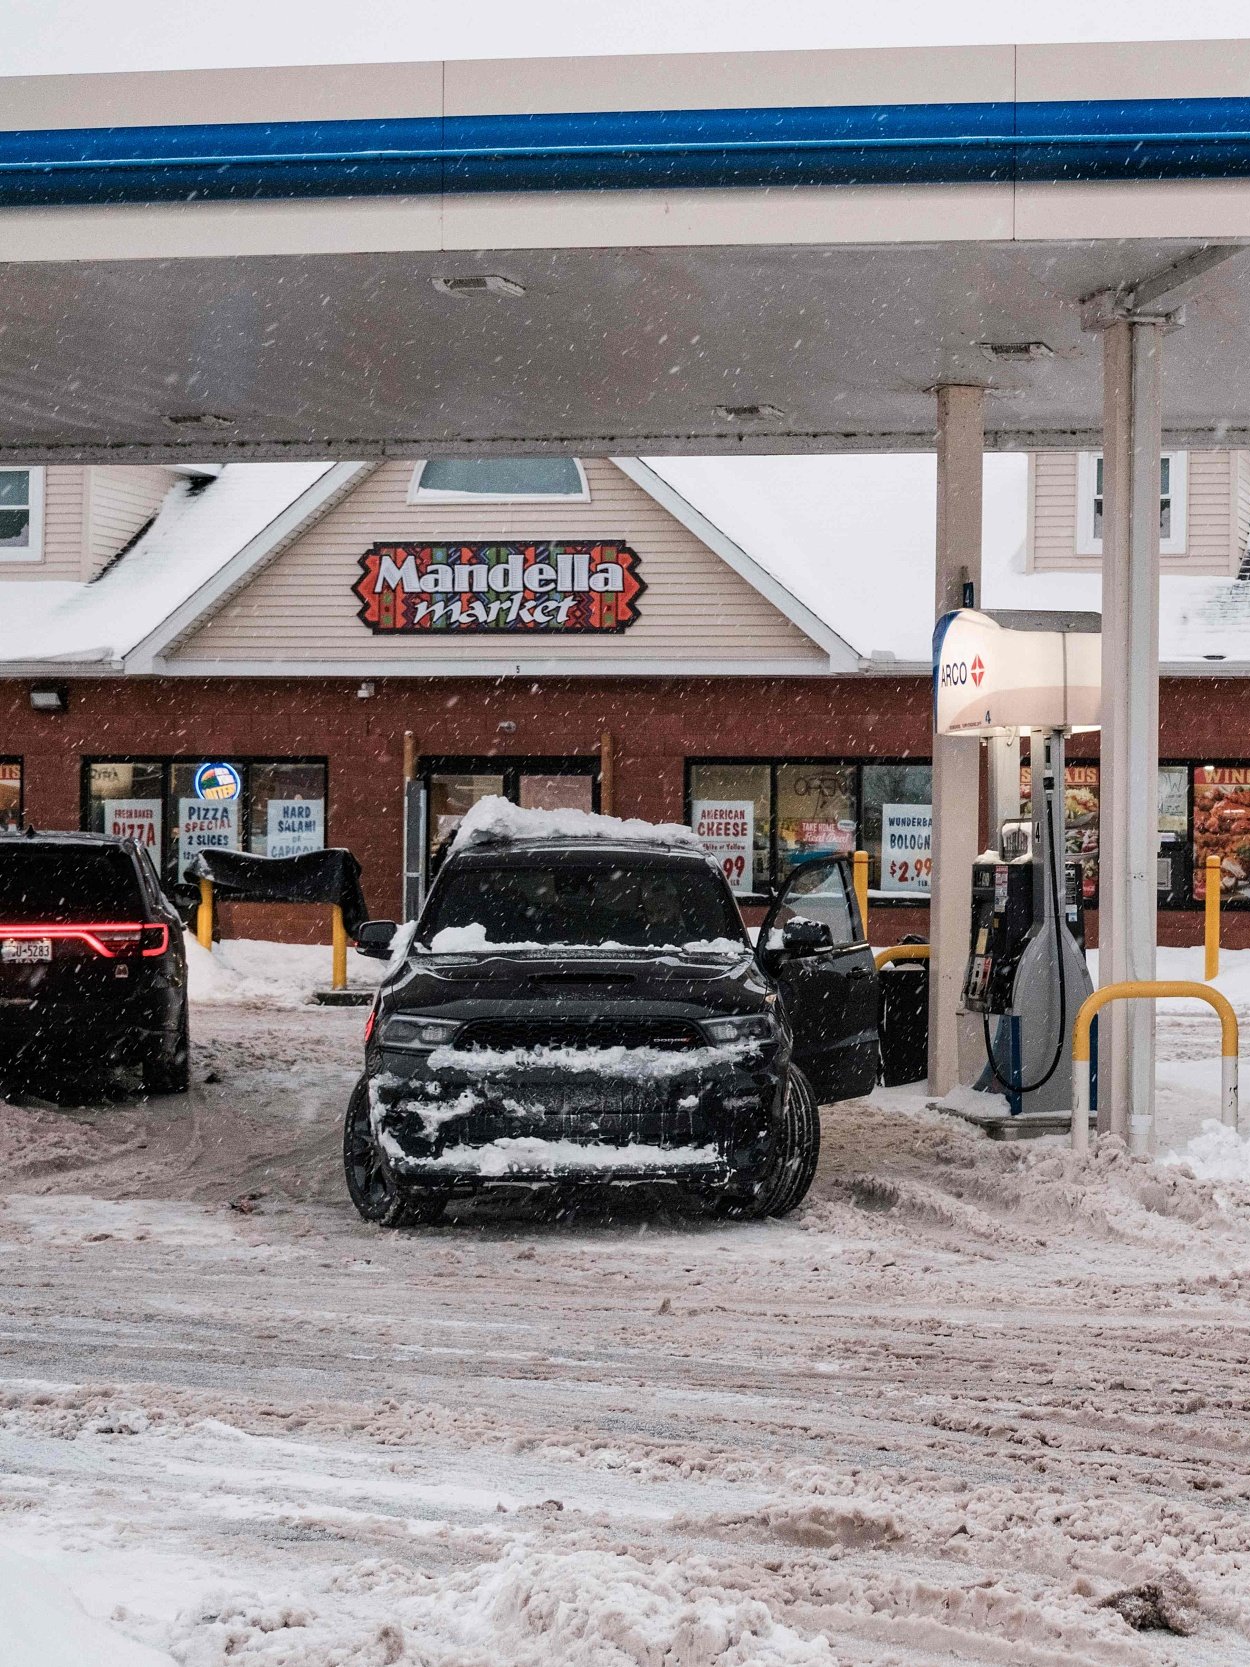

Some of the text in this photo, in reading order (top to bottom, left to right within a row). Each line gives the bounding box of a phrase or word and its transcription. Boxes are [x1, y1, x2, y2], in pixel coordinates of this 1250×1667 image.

[374, 554, 623, 593] Mandella
[413, 592, 577, 624] market
[940, 662, 968, 688] ARCO
[985, 710, 991, 724] 4
[188, 806, 229, 821] PIZZA
[283, 805, 311, 819] HARD
[701, 809, 745, 820] AMERICAN
[184, 819, 232, 833] SPECIAL
[277, 820, 316, 833] SALAMI
[802, 822, 818, 833] TAKE
[889, 817, 932, 827] WUNDERBA
[697, 822, 748, 837] CHEESE
[1035, 822, 1040, 842] 4
[187, 834, 229, 846] 2 SLICES
[890, 833, 931, 850] BOLOGN
[889, 857, 933, 883] $2.99
